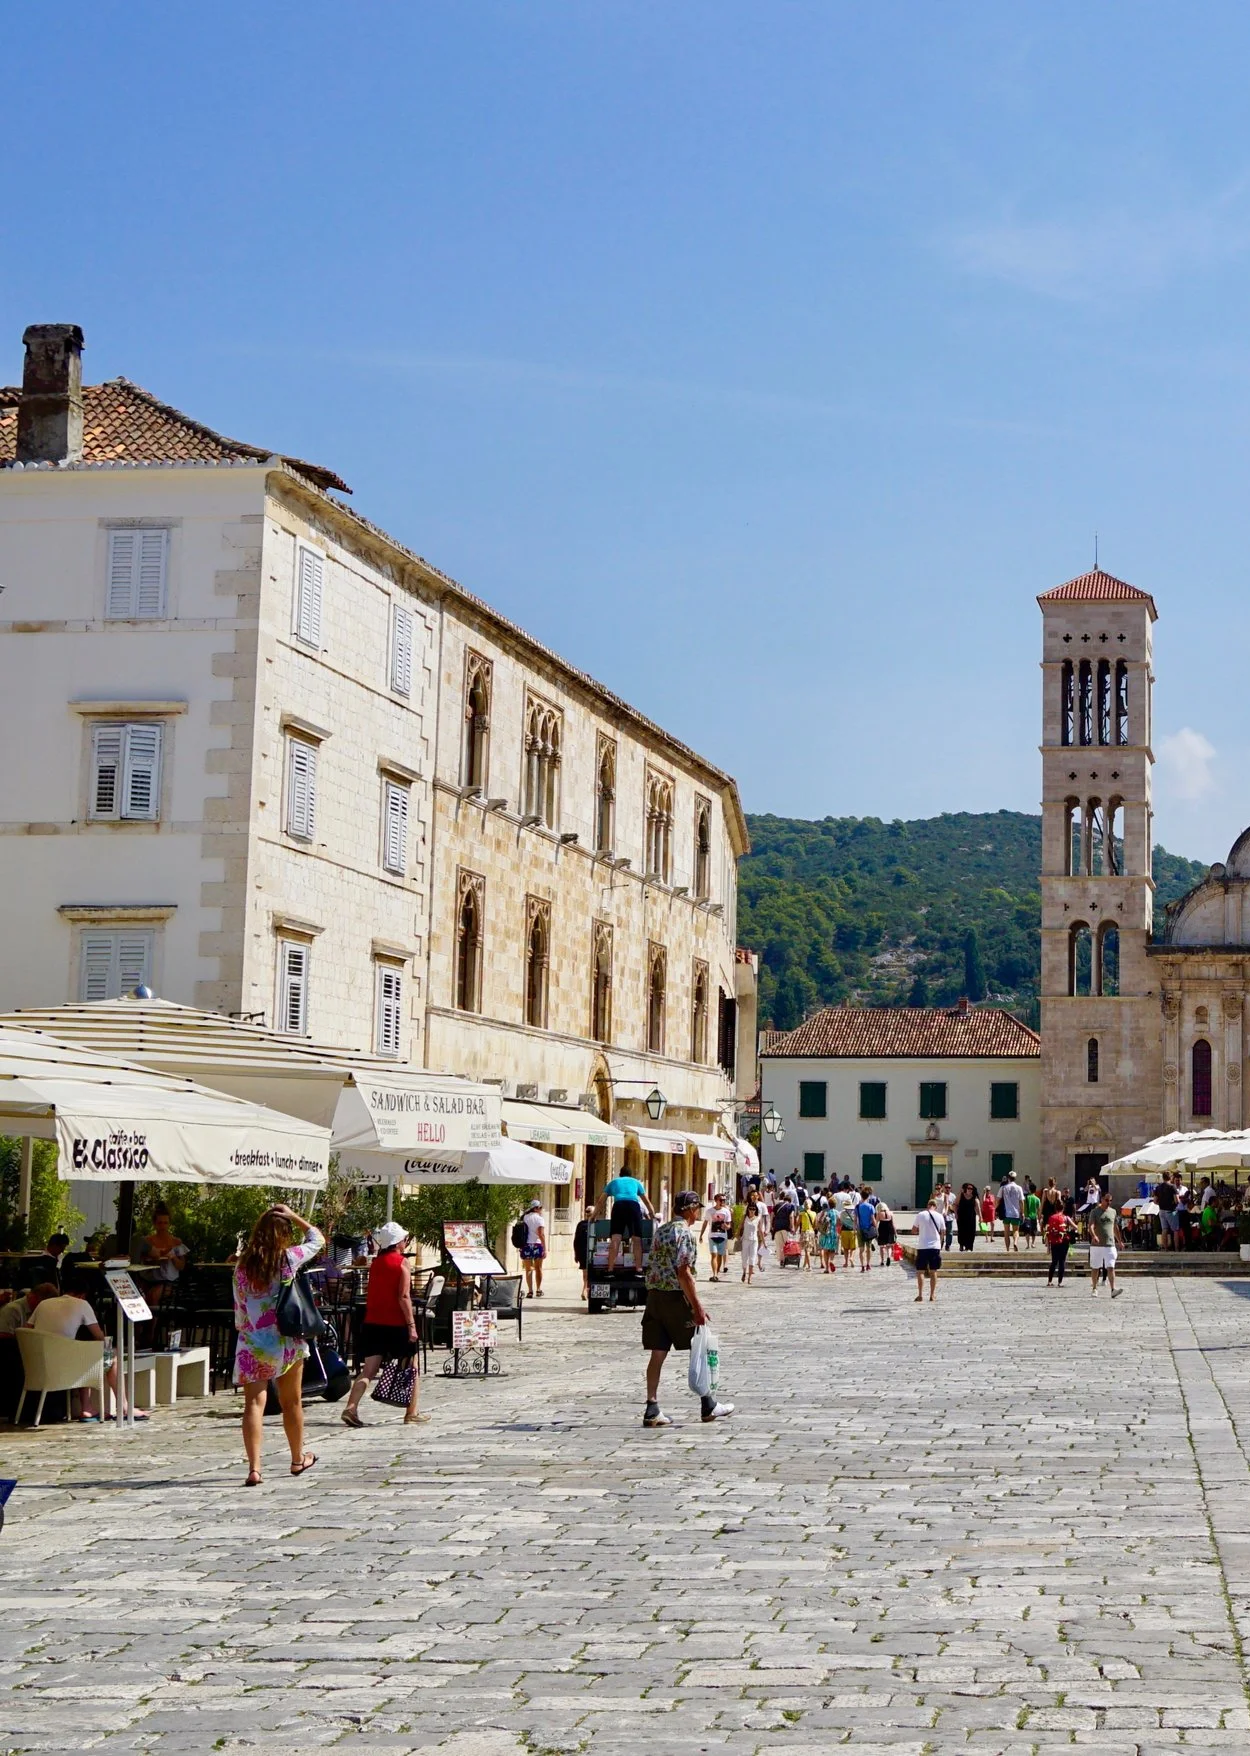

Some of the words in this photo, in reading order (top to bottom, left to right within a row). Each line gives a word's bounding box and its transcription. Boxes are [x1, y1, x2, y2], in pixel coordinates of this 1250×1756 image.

[371, 1090, 421, 1113] SANDWICH
[424, 1095, 431, 1112] &
[433, 1096, 464, 1114] SALAD
[466, 1098, 486, 1115] BAR
[133, 1130, 147, 1145] bar
[417, 1122, 446, 1144] HELLO
[234, 1149, 270, 1166] breakfast
[275, 1151, 294, 1170] lunch
[298, 1155, 319, 1173] dinner
